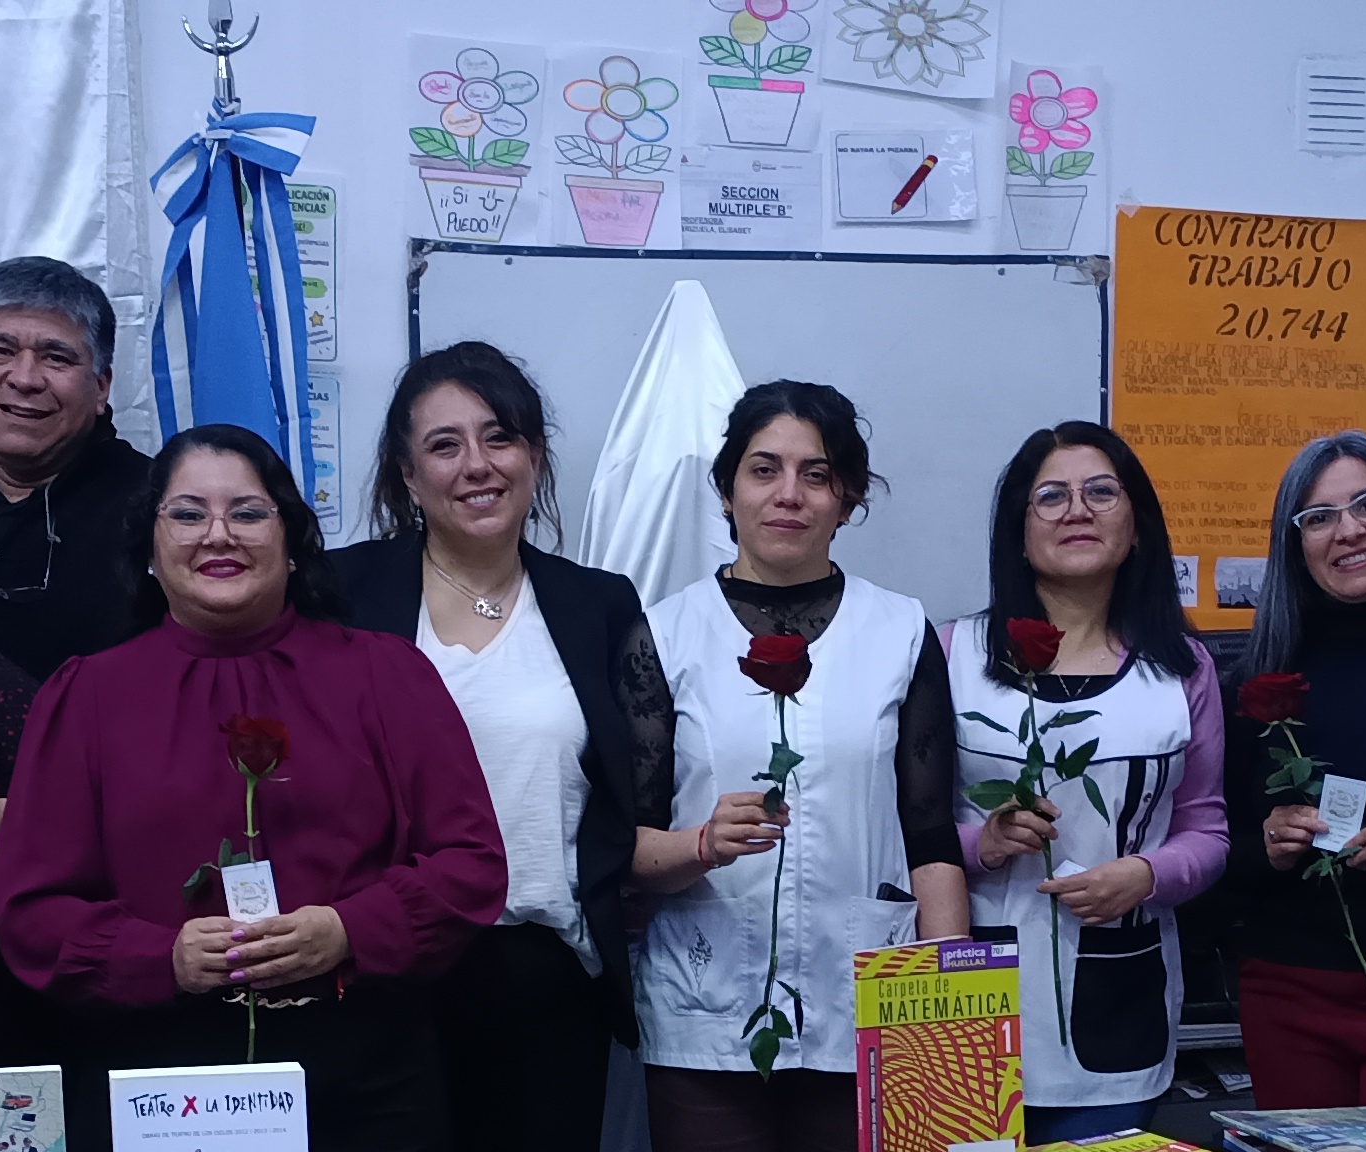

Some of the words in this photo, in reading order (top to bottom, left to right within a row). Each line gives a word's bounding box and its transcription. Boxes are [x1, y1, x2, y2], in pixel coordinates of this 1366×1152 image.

[288, 188, 330, 201] LICACIÓN
[290, 202, 326, 214] ENCIAS
[721, 185, 779, 200] SECCION
[1154, 211, 1337, 252] CONTRATO
[1187, 253, 1352, 292] TRABAJO
[1215, 302, 1350, 343] 20.744
[878, 978, 928, 999] Carpeta
[935, 974, 950, 995] de
[878, 989, 1011, 1024] MATEMÁTICA
[1001, 1020, 1012, 1054] 1
[127, 1093, 175, 1118] TEATRO
[181, 1094, 198, 1118] X
[205, 1098, 219, 1113] LA
[224, 1090, 294, 1116] IDENTIDAD
